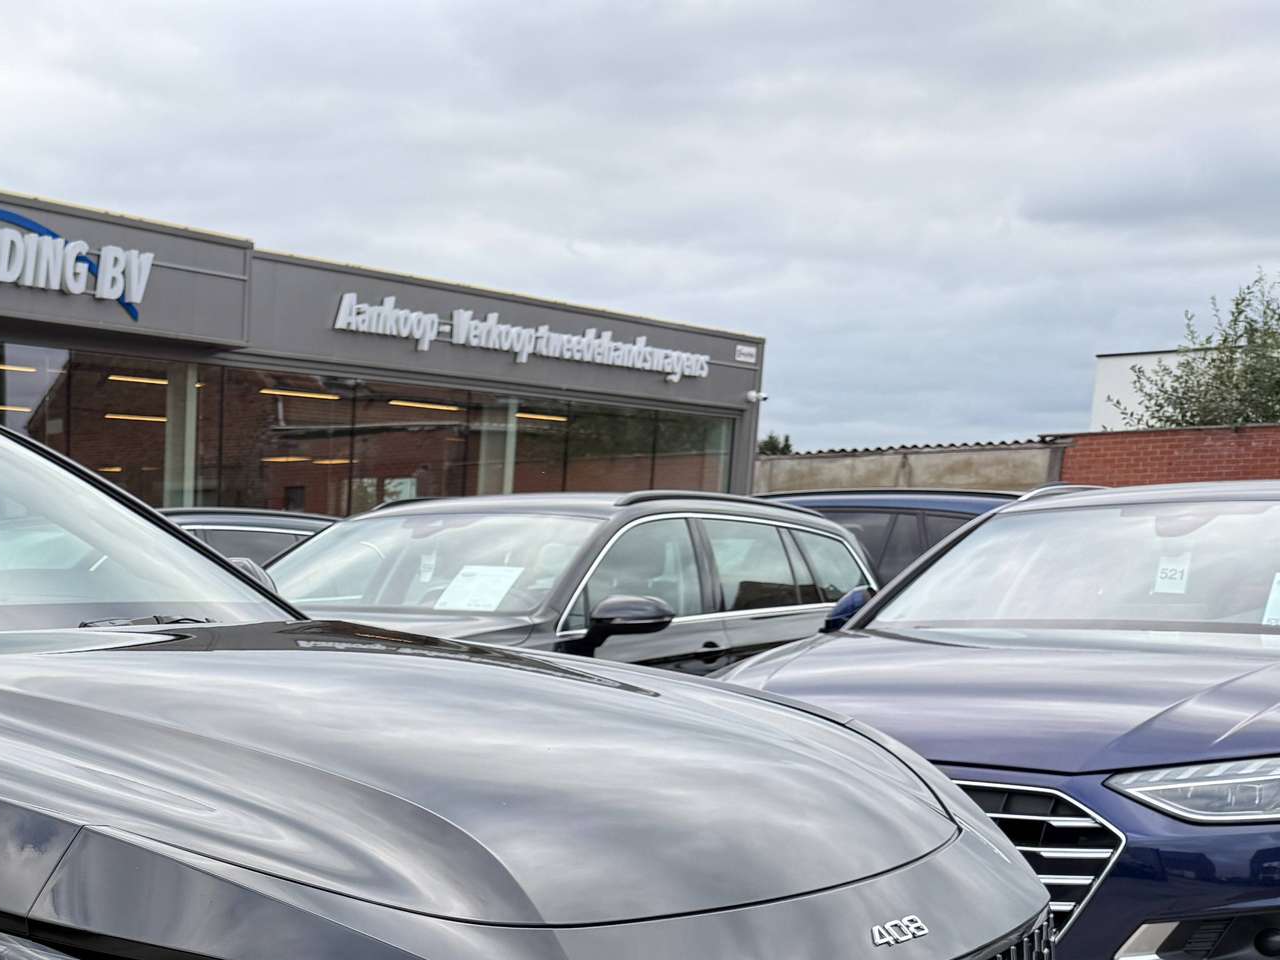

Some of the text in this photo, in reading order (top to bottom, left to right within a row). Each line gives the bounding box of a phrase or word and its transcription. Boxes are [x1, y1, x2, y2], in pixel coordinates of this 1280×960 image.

[95, 245, 155, 304] BV
[334, 292, 438, 351] Aankoop
[452, 309, 535, 363] Verkoop
[535, 325, 710, 383] tweedehandswagens
[1159, 567, 1185, 581] 521
[870, 915, 929, 947] 408
